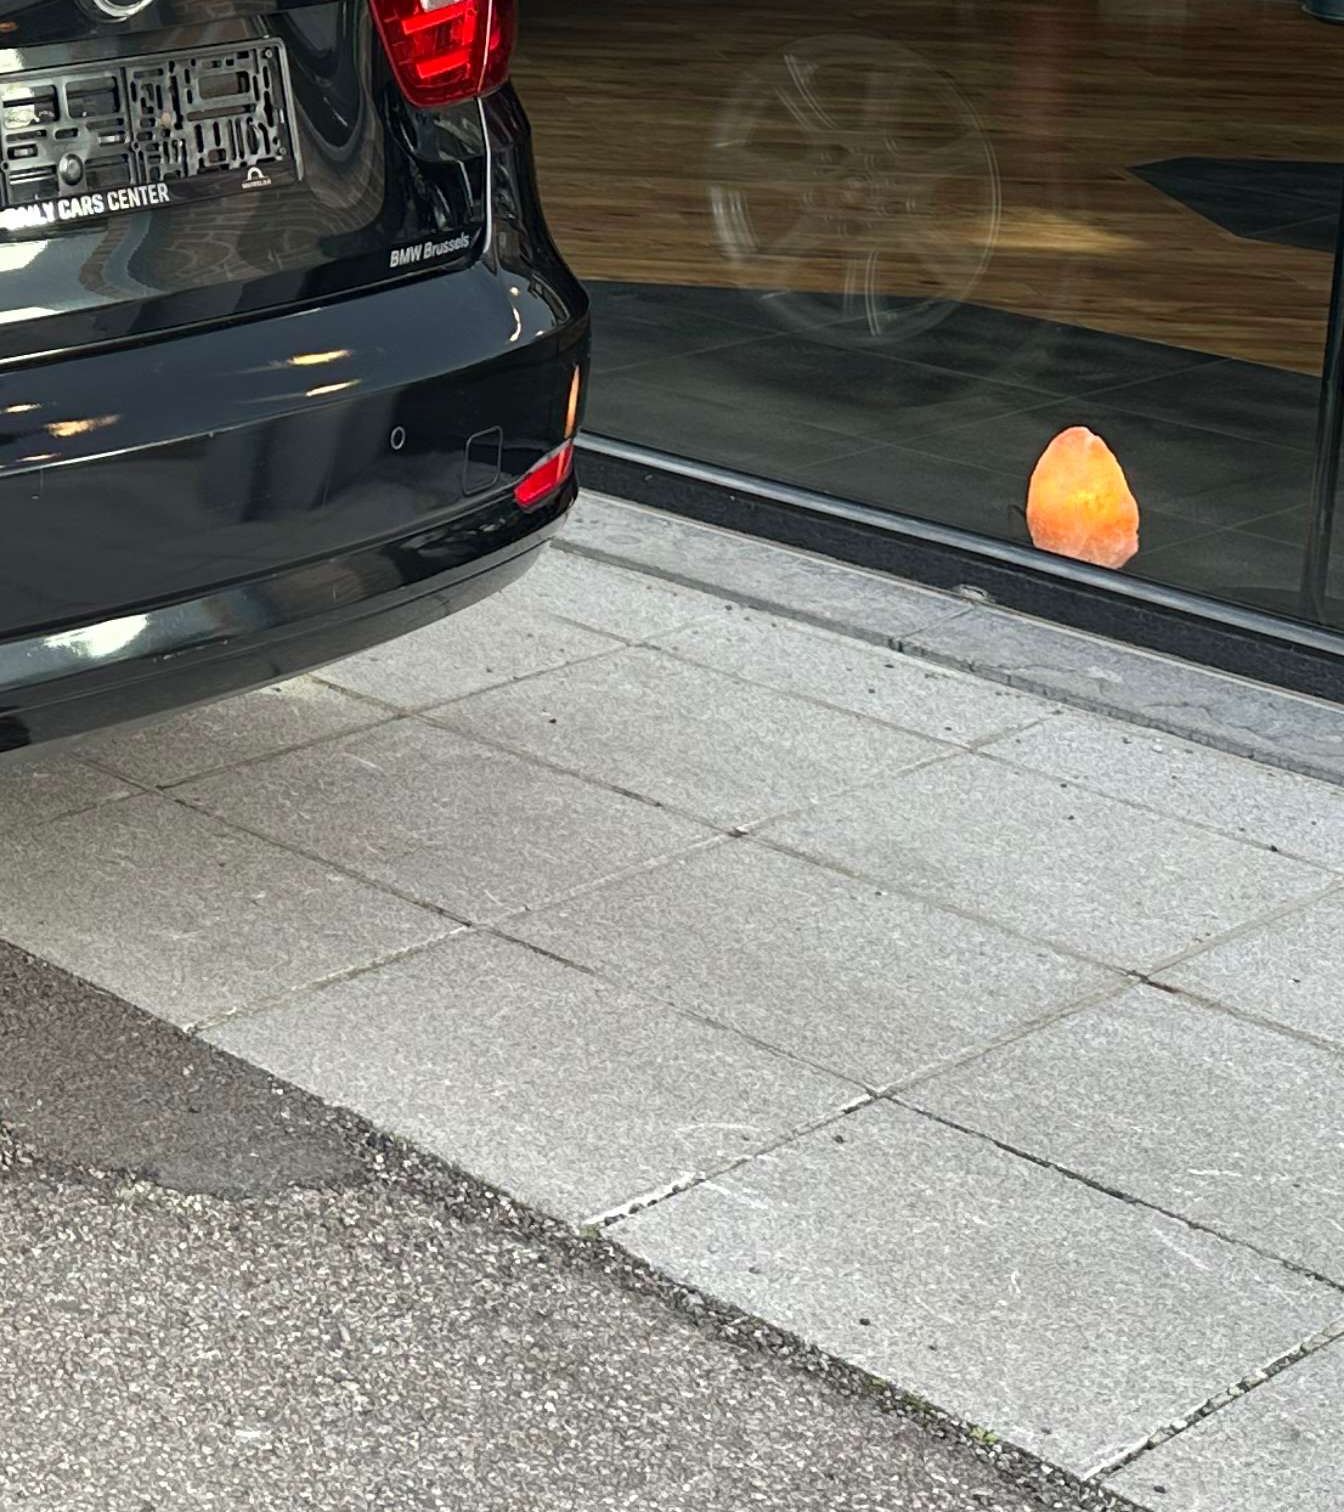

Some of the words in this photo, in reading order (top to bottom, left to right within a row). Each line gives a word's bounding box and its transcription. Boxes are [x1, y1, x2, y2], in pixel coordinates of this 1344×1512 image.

[57, 193, 105, 220] CARS
[107, 183, 170, 211] CENTER
[389, 244, 423, 268] BMW
[423, 232, 470, 259] Brussels
